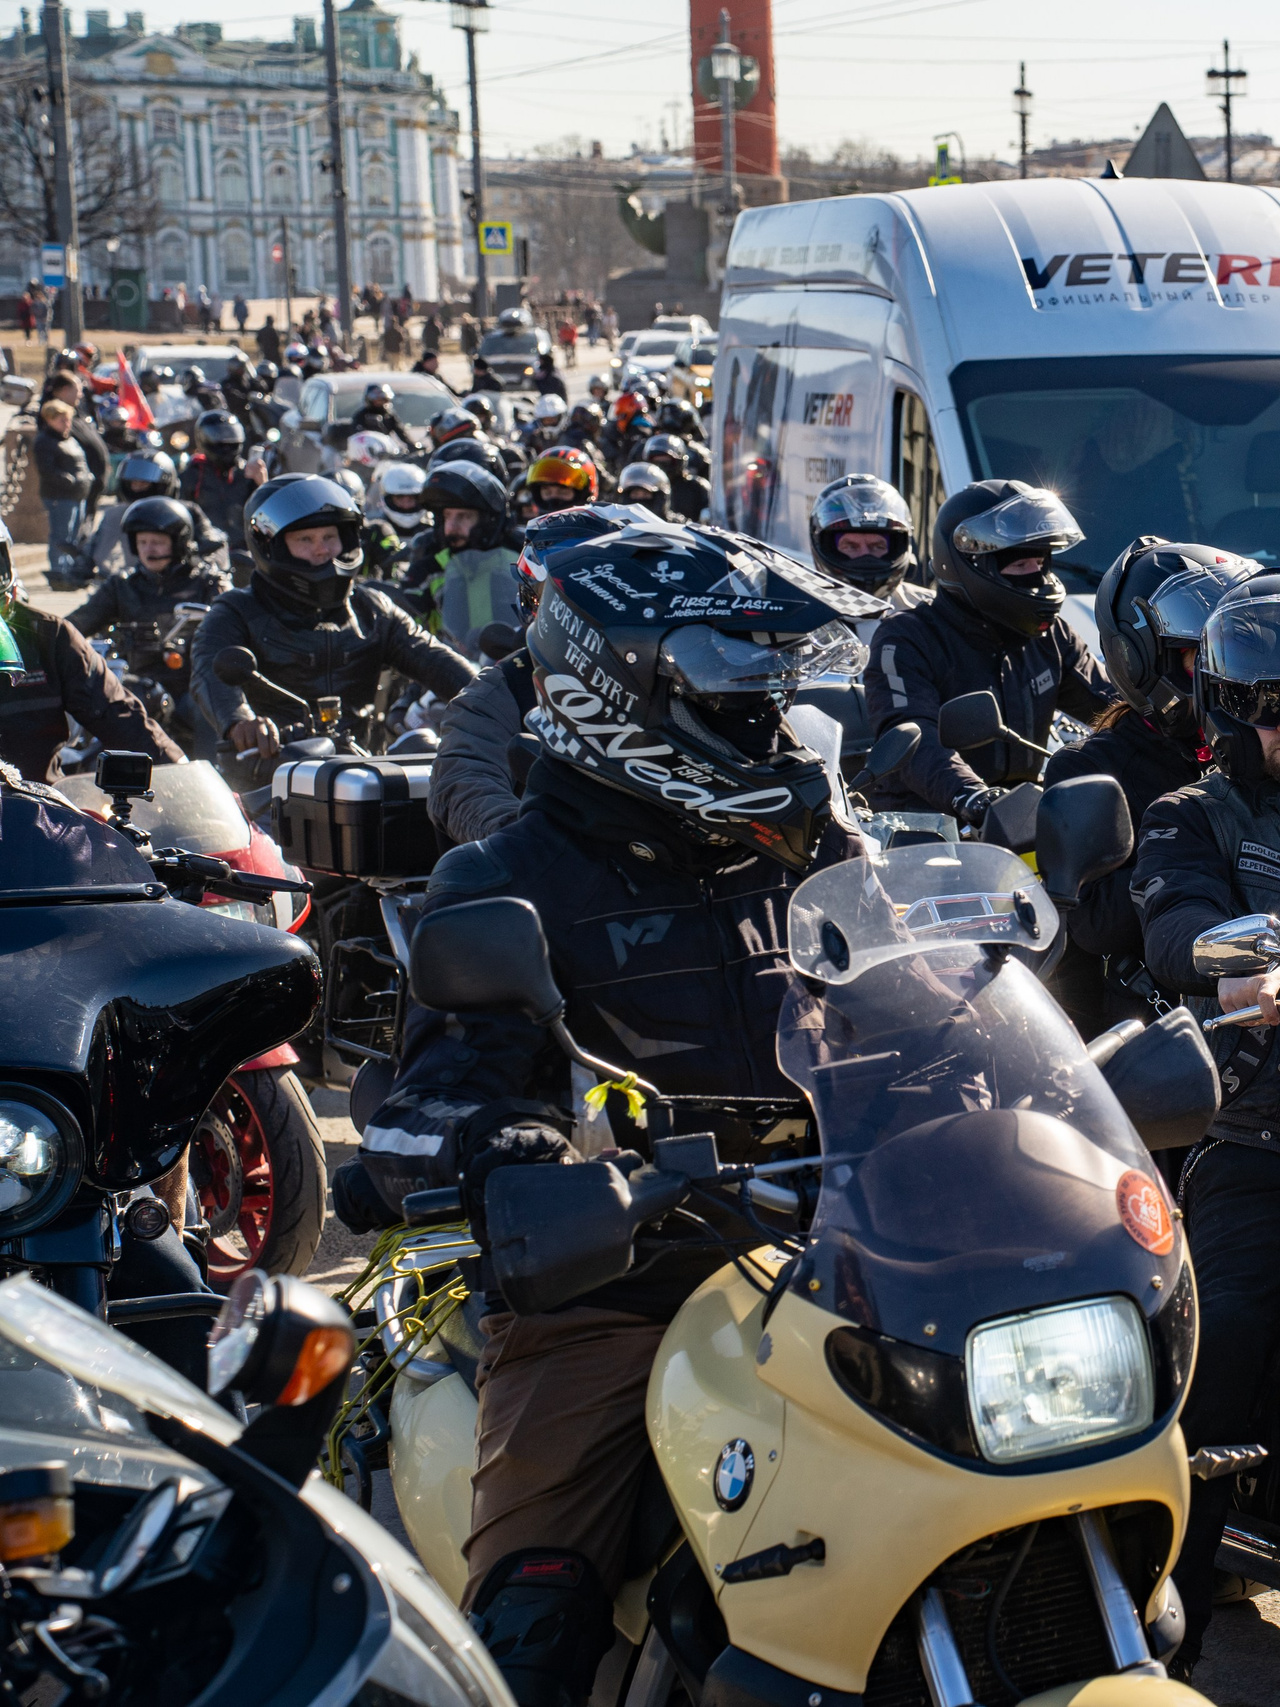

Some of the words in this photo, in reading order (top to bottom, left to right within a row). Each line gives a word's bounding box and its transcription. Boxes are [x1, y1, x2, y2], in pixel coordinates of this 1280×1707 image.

[1035, 290, 1194, 309] ОФИЦИАЛЬНЫЙ
[1206, 291, 1272, 305] ДИЛЕР
[803, 391, 854, 427] VETERR
[568, 568, 627, 612] Demons
[594, 563, 659, 599] Speed
[548, 592, 585, 639] BORN
[581, 627, 605, 655] IN
[563, 639, 593, 677] THE
[589, 666, 640, 713] DIRT
[671, 764, 714, 784] 1970
[721, 1439, 755, 1470] BMW
